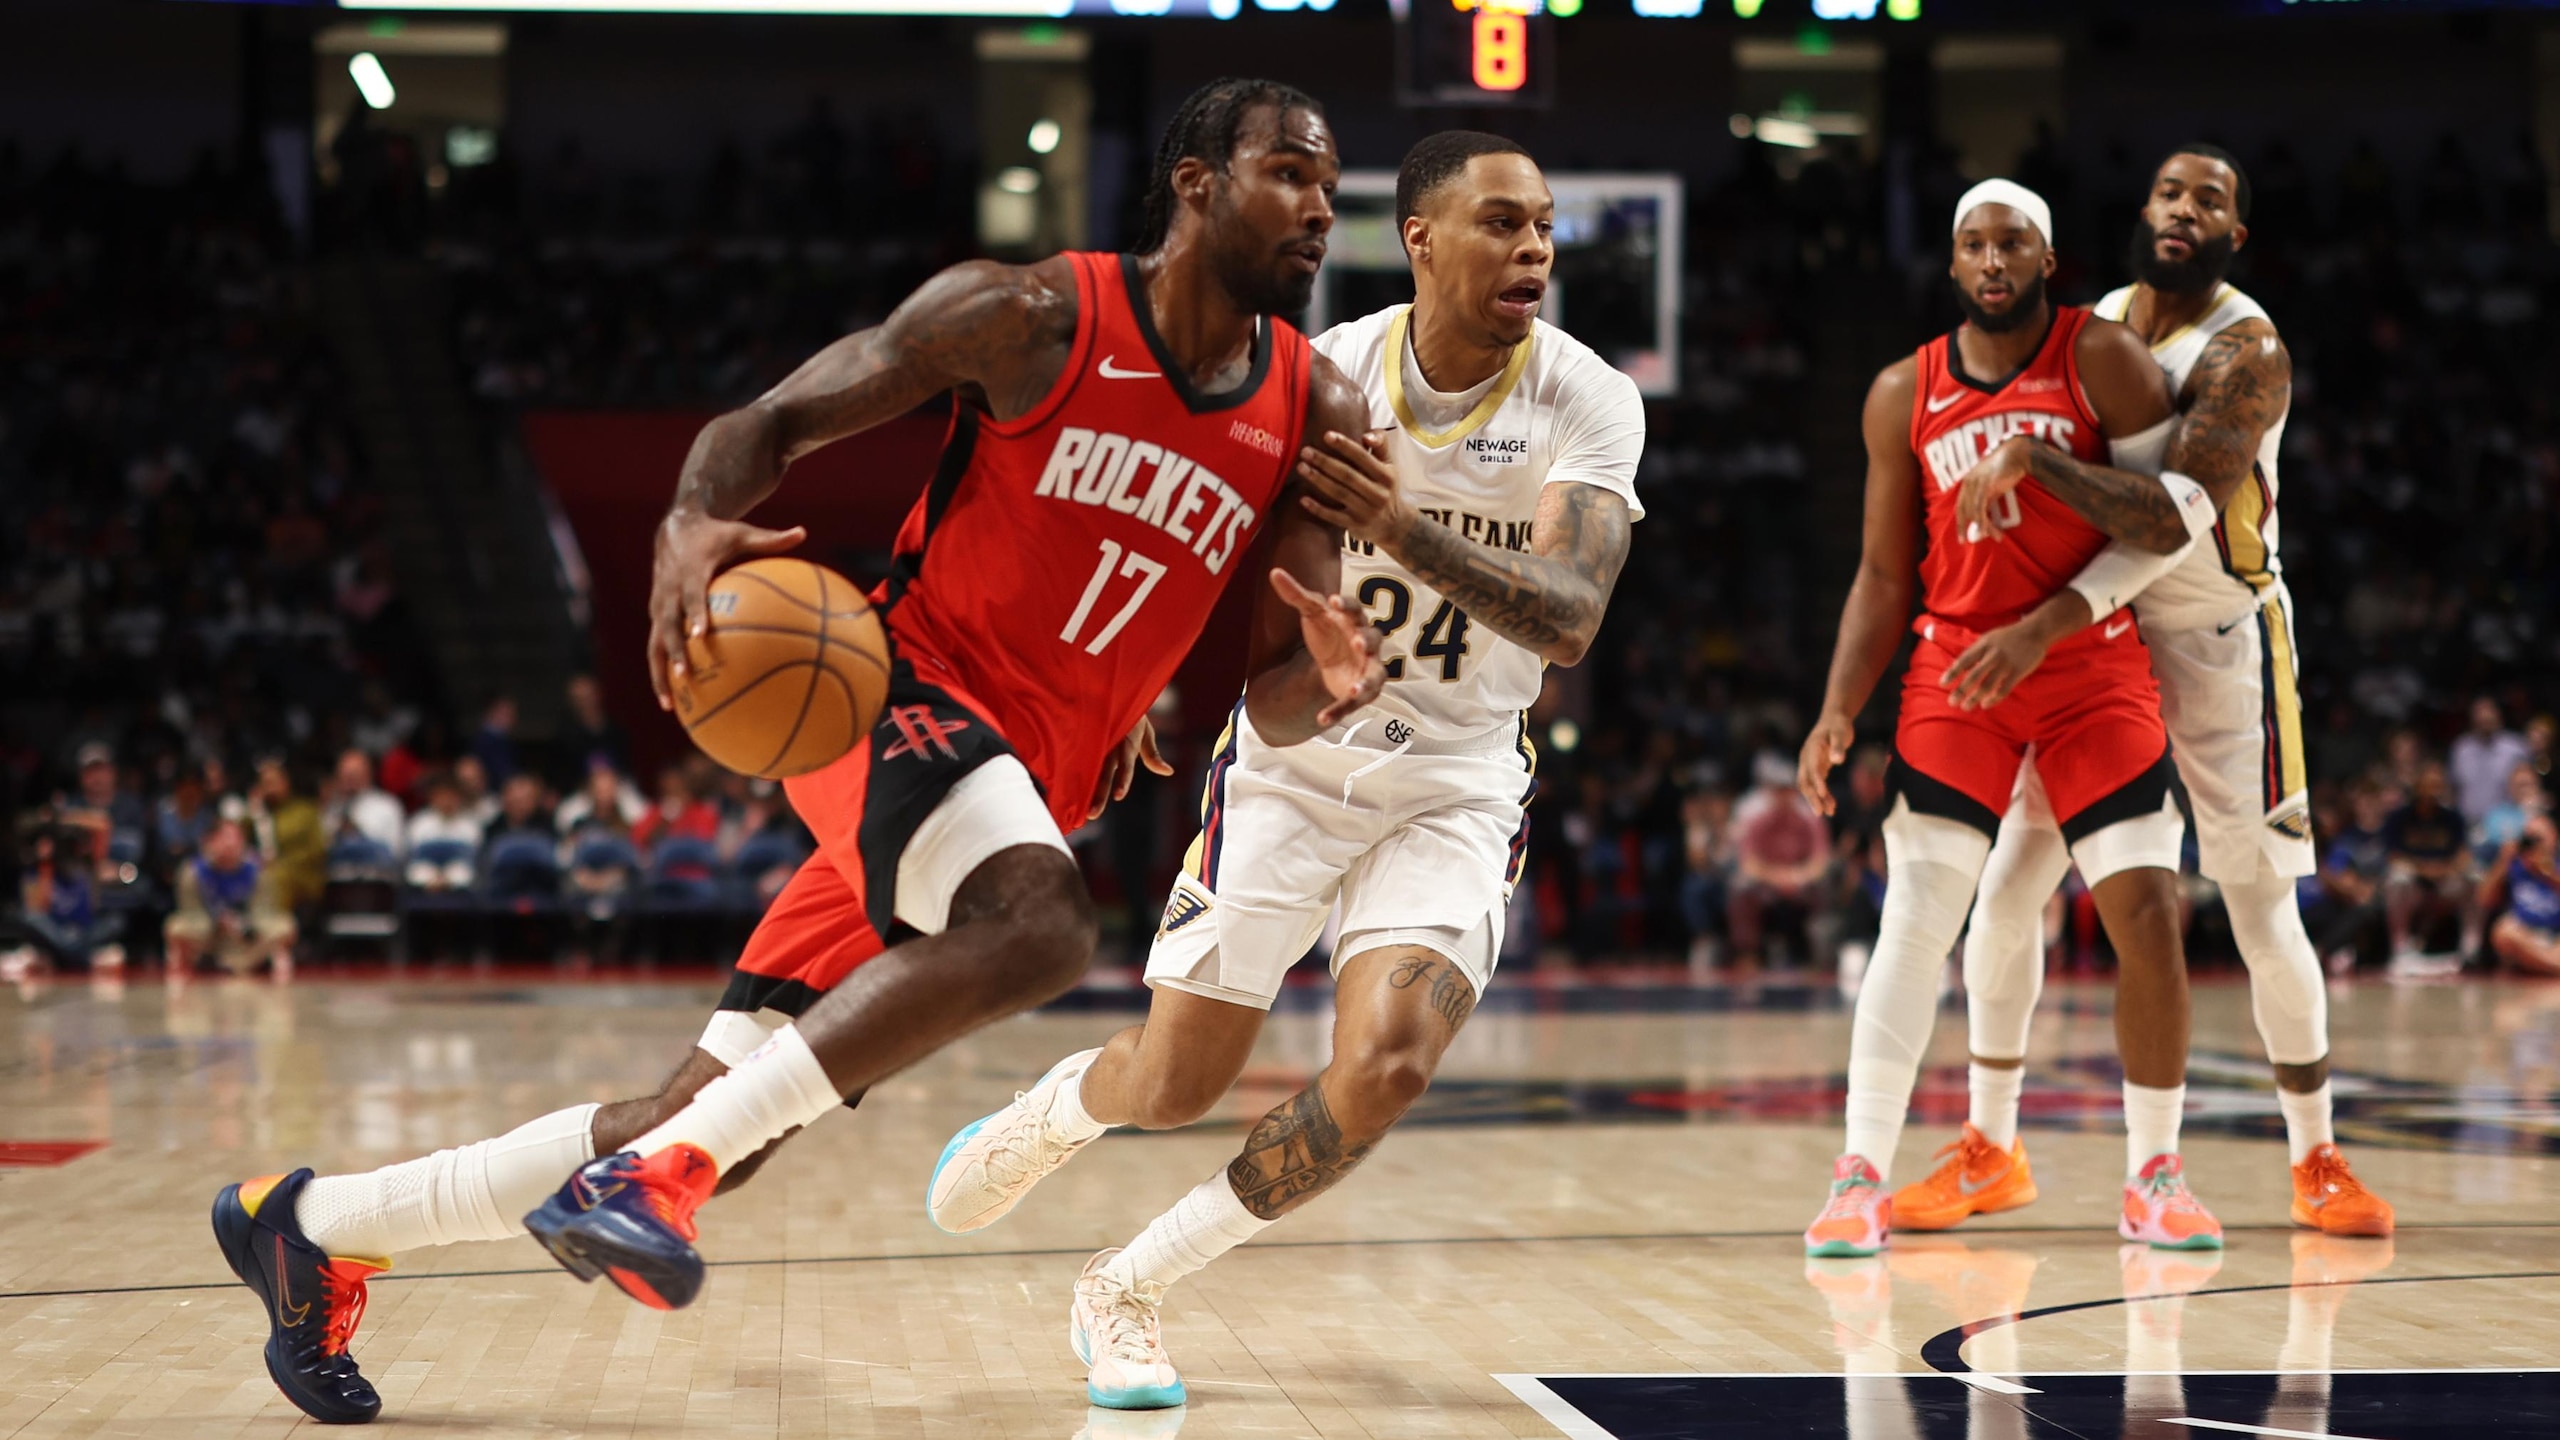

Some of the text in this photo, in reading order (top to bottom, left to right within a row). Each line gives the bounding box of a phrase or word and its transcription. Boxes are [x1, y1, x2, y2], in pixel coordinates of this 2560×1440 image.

[1472, 11, 1526, 91] 8
[1466, 439, 1527, 453] NEWAGE
[1479, 455, 1513, 463] GRILLS
[1924, 411, 2075, 494] ROCKETS
[1034, 426, 1256, 576] ROCKETS
[1418, 507, 1534, 554] LEAN
[1059, 537, 1168, 657] 17
[1356, 573, 1471, 684] 24
